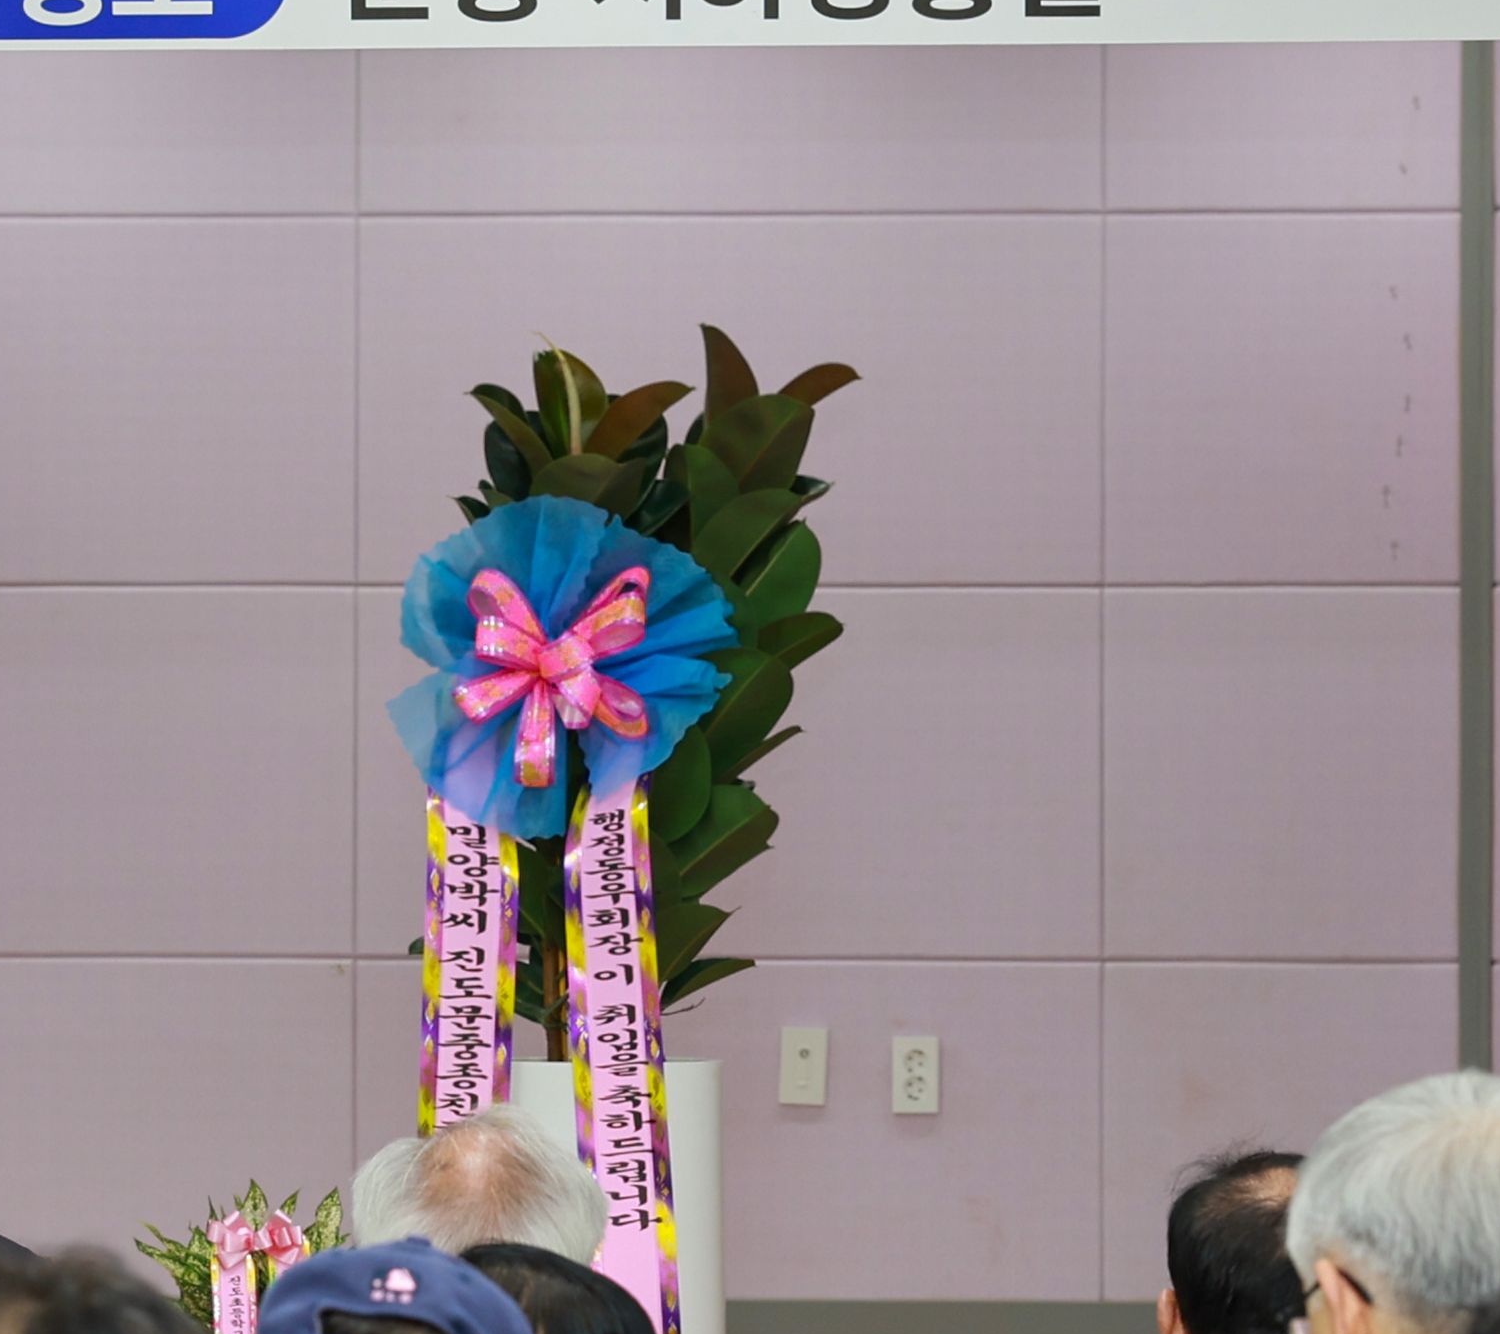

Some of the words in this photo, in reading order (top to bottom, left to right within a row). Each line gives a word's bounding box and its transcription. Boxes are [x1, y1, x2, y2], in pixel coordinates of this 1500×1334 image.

[442, 823, 500, 936] 밀양박씨
[585, 808, 644, 958] 행정동우회장
[433, 946, 493, 1129] 진도문중종친
[593, 963, 635, 987] 이
[593, 1003, 650, 1079] 취임을
[597, 1085, 663, 1233] 축하드립니다
